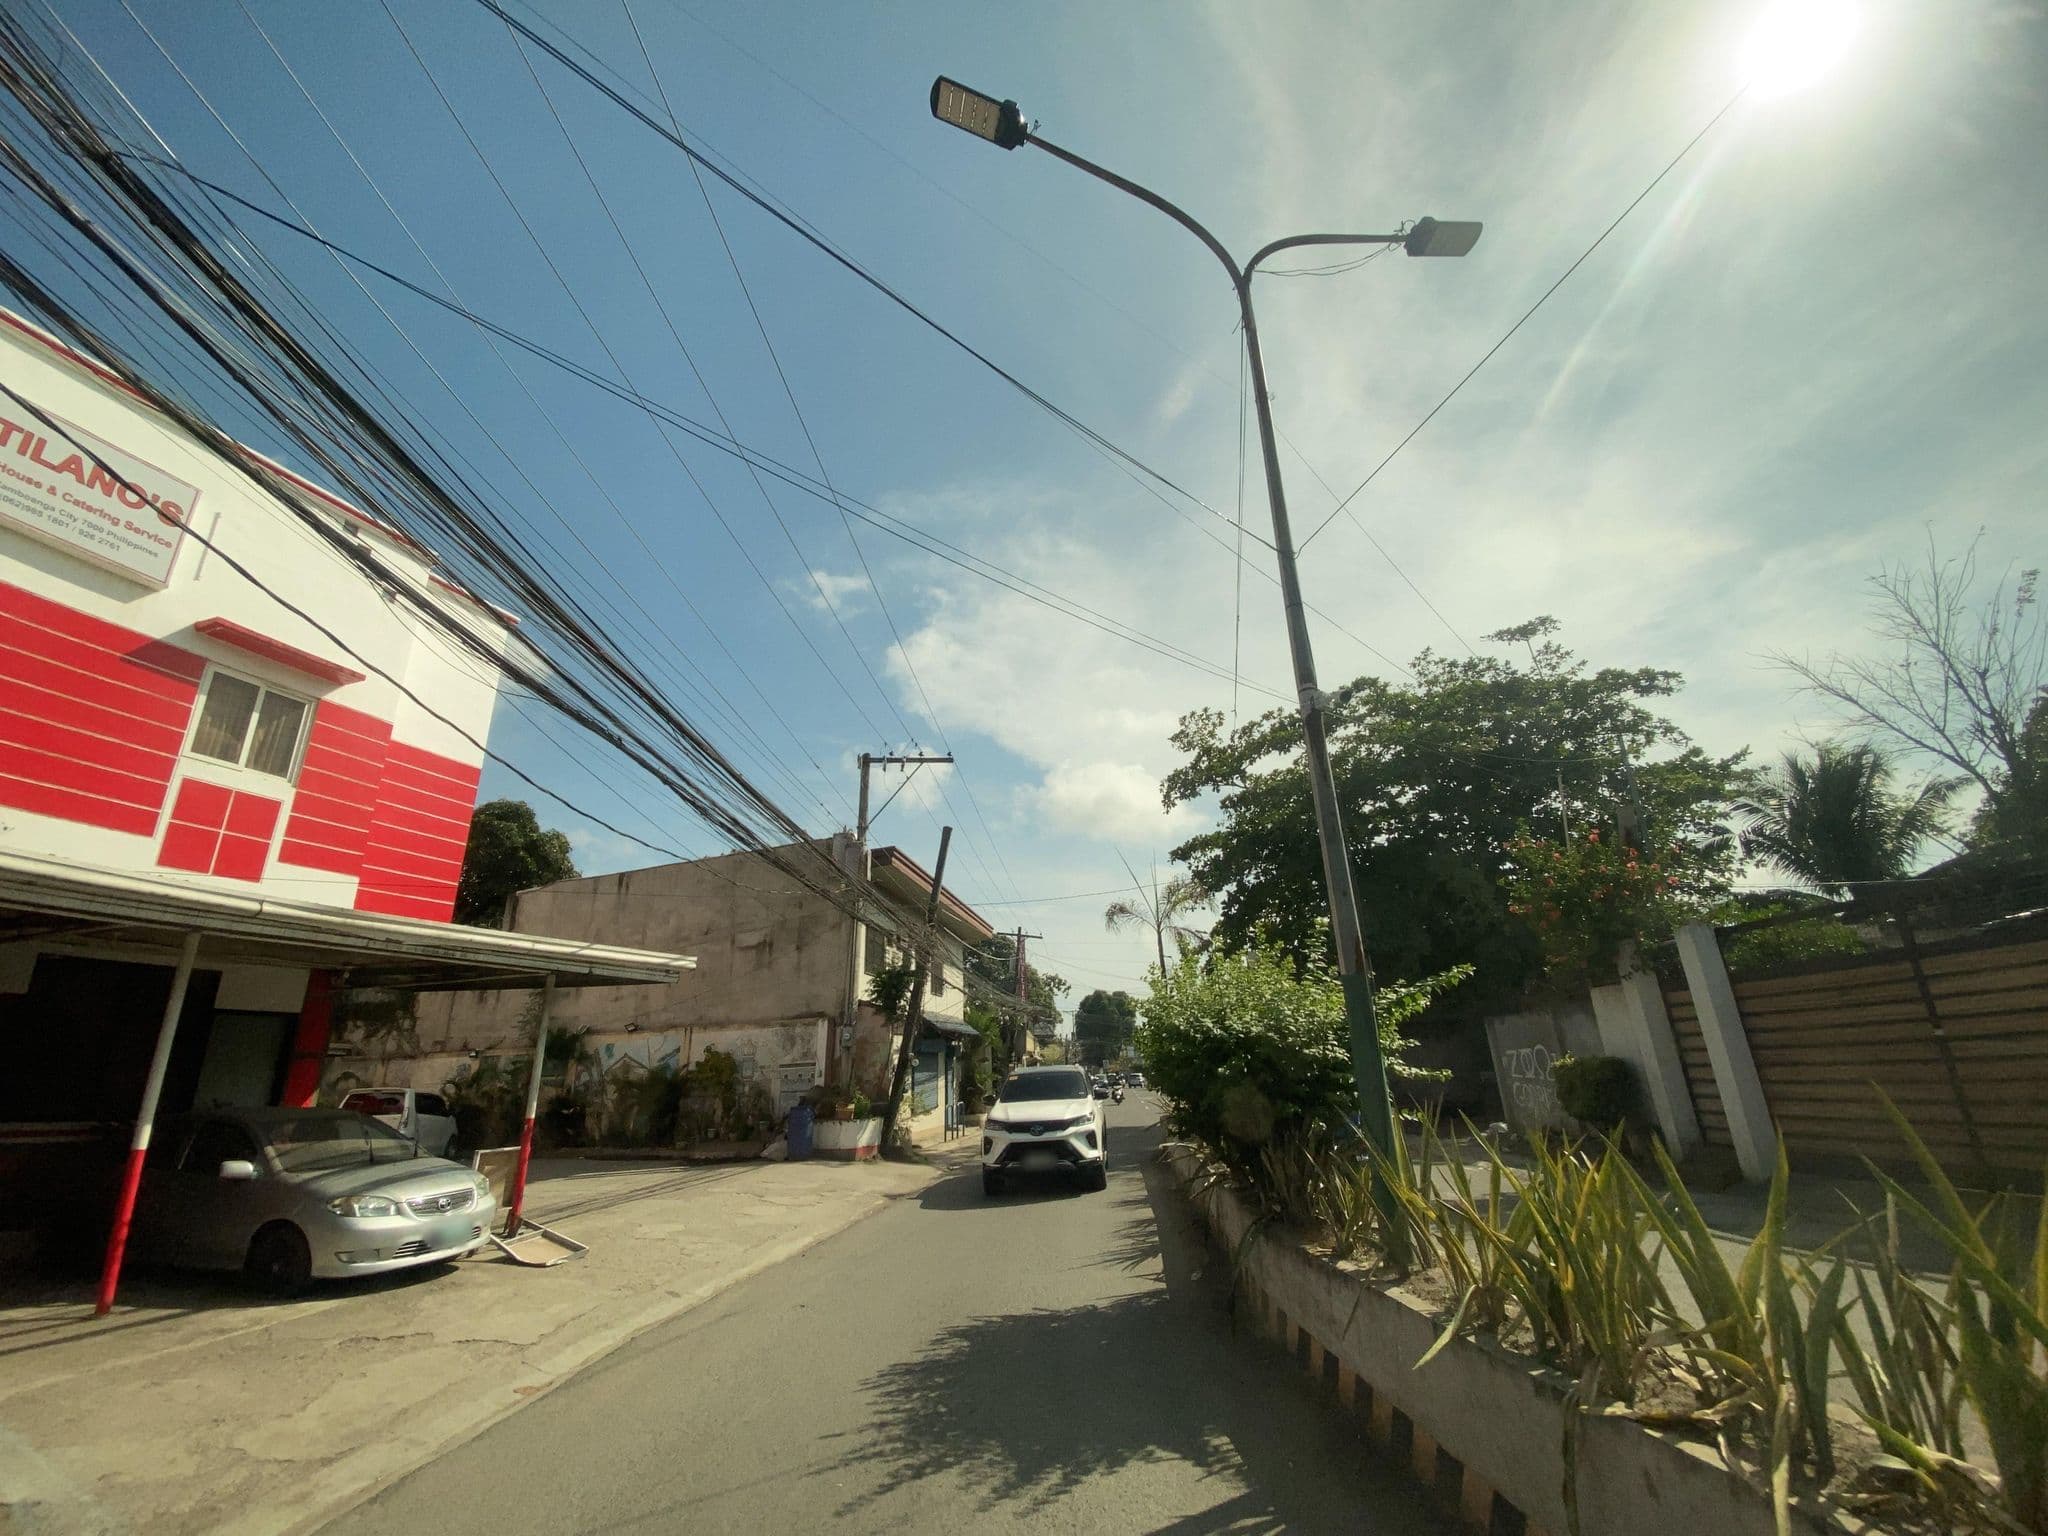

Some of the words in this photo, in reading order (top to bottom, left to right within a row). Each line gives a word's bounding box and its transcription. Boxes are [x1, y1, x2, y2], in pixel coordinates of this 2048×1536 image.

[0, 481, 56, 512] amboanga
[59, 509, 80, 523] City
[81, 518, 105, 534] 7000
[106, 529, 160, 558] Philippines
[47, 485, 57, 497] &
[62, 492, 120, 527] Catering
[124, 520, 173, 549] Service
